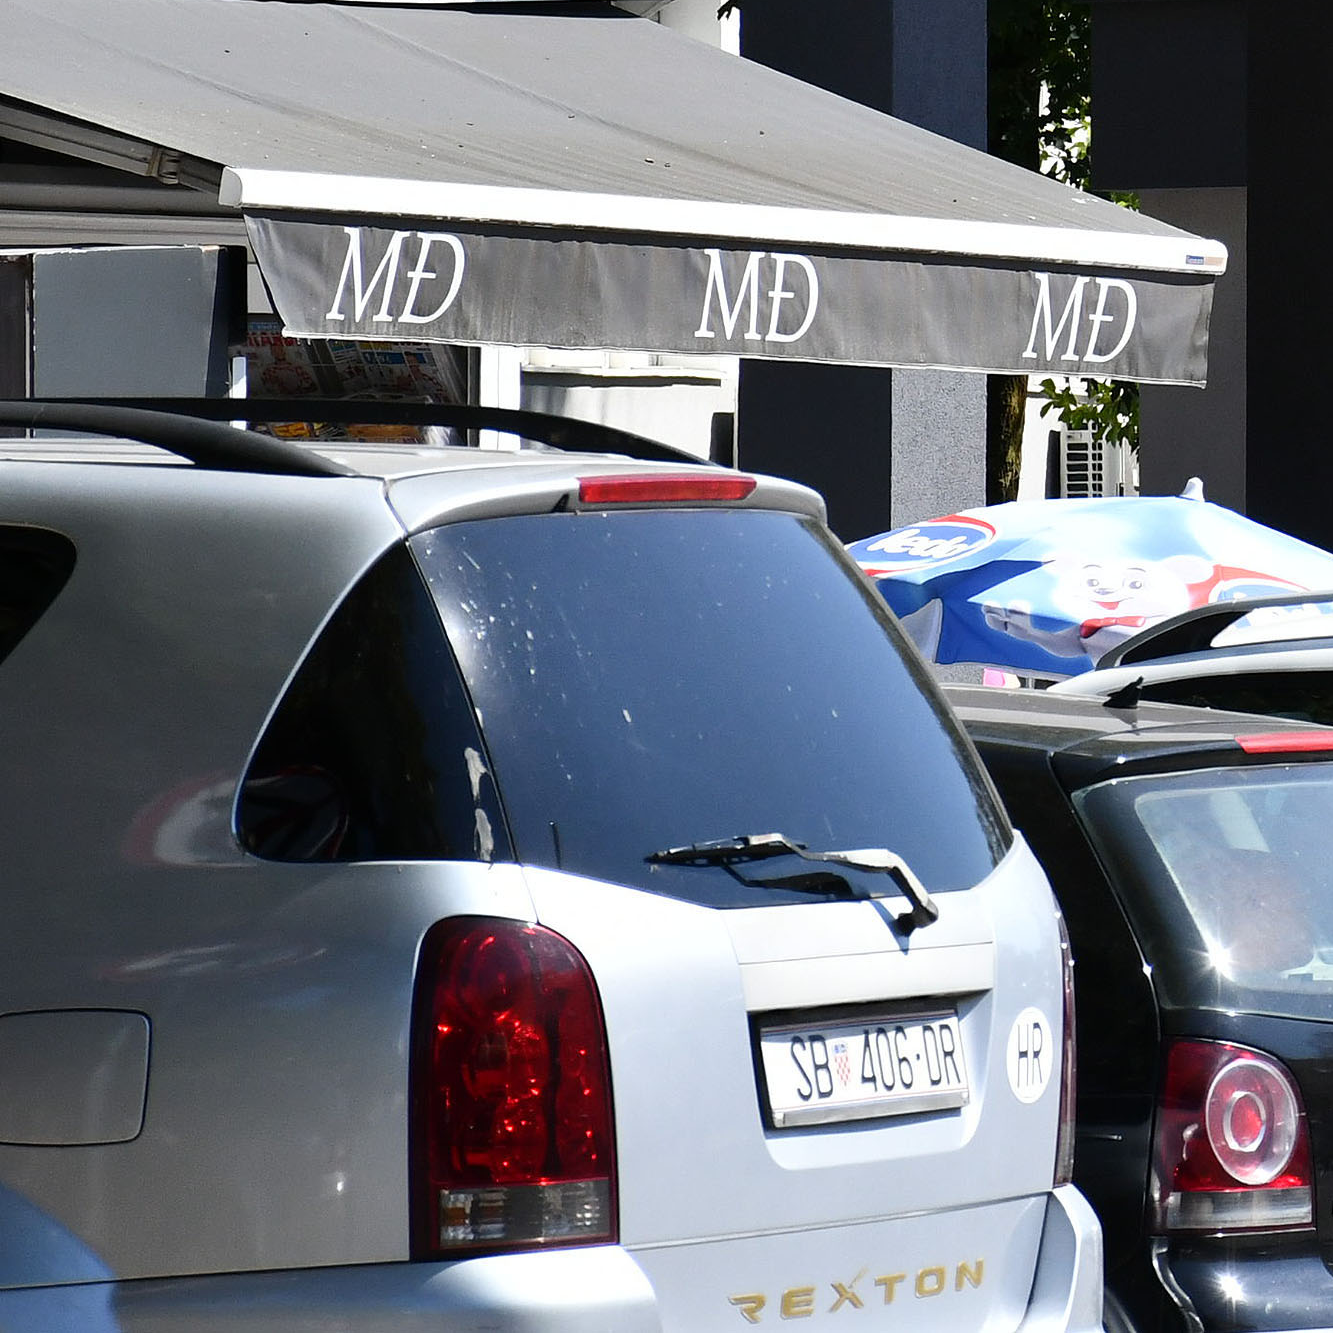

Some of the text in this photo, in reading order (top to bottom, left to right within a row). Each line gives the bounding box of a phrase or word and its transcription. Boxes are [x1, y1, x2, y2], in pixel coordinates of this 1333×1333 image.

[325, 226, 469, 325] MĐ
[694, 248, 819, 343] MĐ
[1022, 271, 1138, 363] MĐ
[790, 1034, 834, 1101] SB
[1016, 1021, 1043, 1089] HR
[727, 1258, 985, 1325] REXTON
